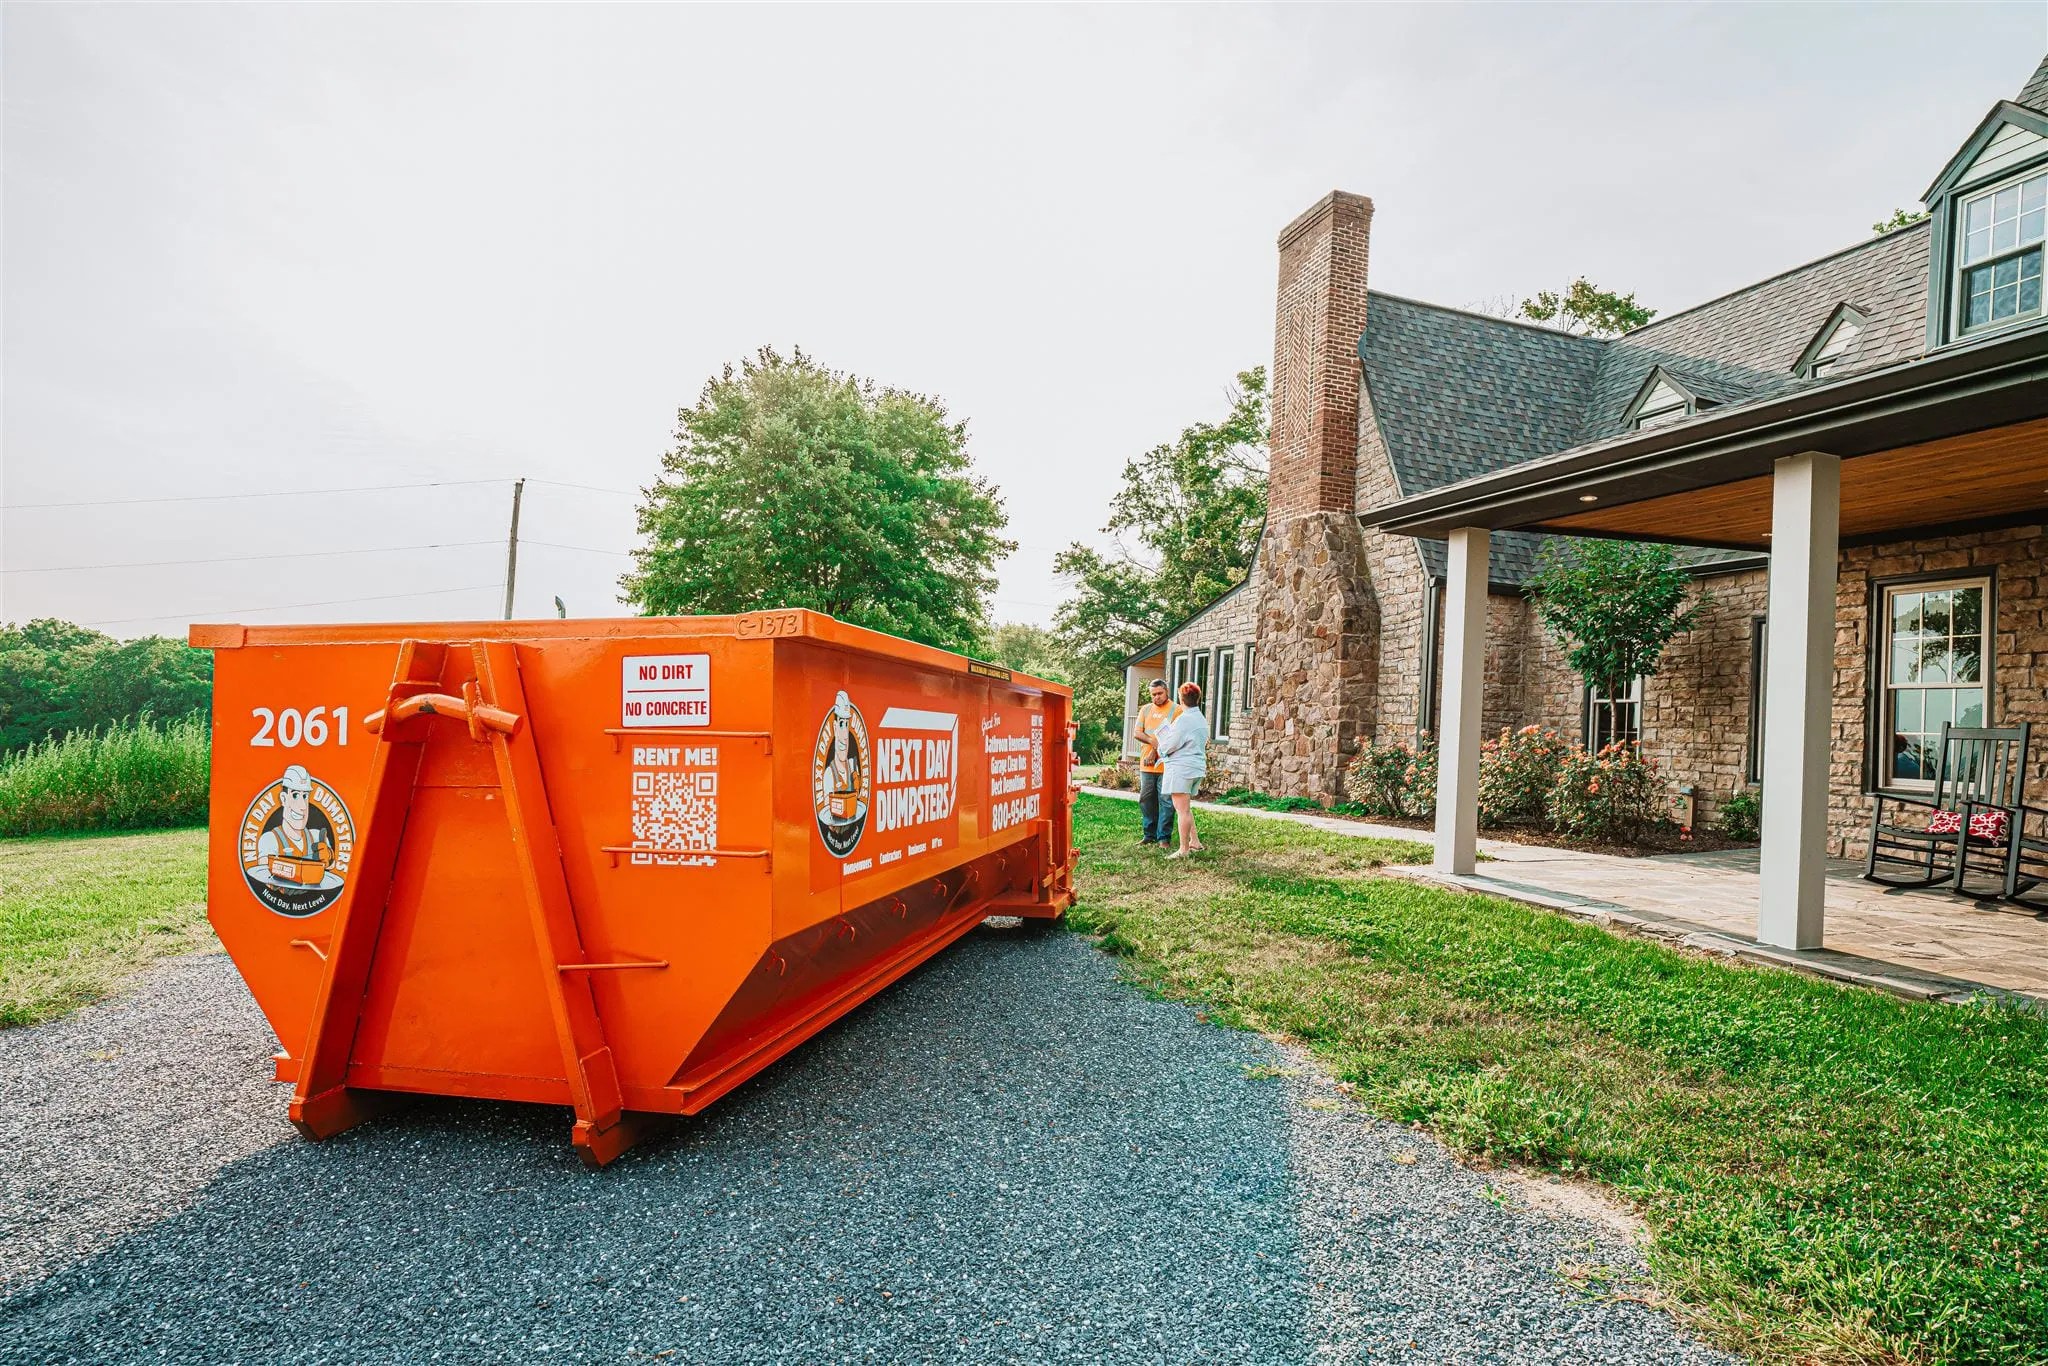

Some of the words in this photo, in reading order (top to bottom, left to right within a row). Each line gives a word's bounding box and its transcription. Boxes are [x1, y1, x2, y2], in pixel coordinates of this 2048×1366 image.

[736, 614, 798, 636] C-1373
[639, 665, 657, 680] NO
[662, 664, 693, 680] DIRT
[250, 705, 348, 748] 2061
[625, 702, 642, 716] NO
[646, 701, 707, 716] CONCRETE
[633, 747, 680, 766] RENT
[684, 747, 718, 766] ME!
[819, 723, 832, 756] DAY
[851, 712, 869, 800] DUMPSTERS
[878, 738, 922, 784] NEXT
[926, 739, 951, 780] DAY
[815, 756, 824, 808] NEXT
[876, 783, 949, 833] DUMPSTERS
[992, 793, 1040, 832] 800-954-NEXT
[243, 821, 259, 863] NEXT
[252, 792, 276, 822] DAY
[313, 786, 351, 873] DUMPSTERS
[262, 888, 277, 905] Next
[292, 901, 308, 911] Next
[309, 894, 326, 908] Level
